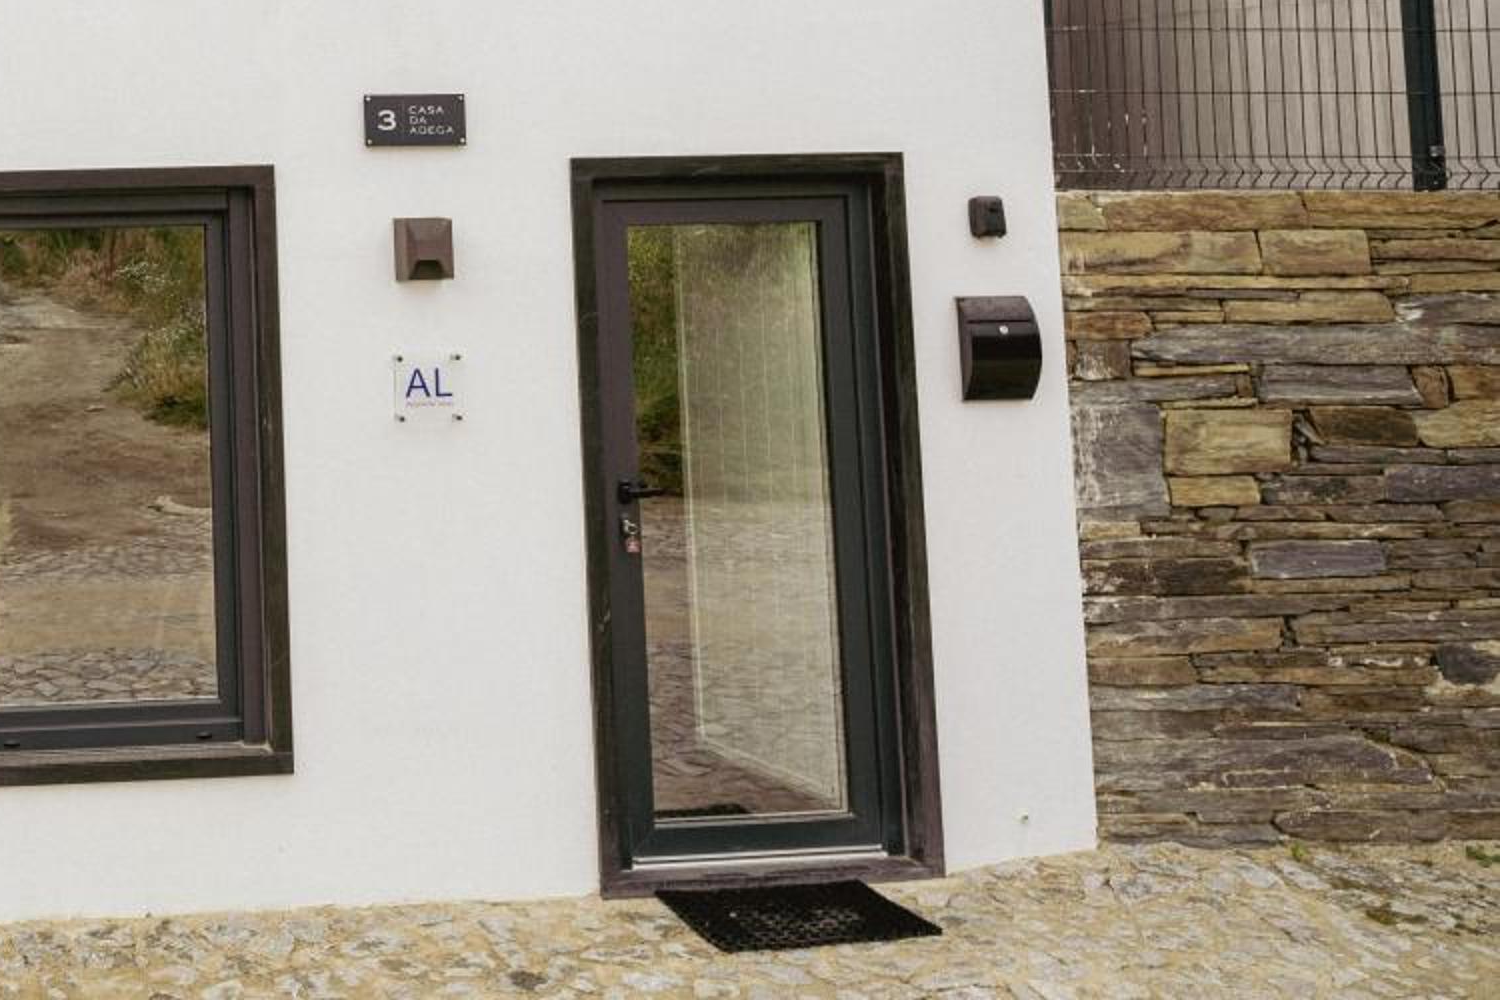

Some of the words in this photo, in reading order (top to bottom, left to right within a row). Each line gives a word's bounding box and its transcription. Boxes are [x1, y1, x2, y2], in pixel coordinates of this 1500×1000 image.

[408, 105, 444, 115] CASA
[377, 109, 397, 131] 3
[409, 116, 427, 125] DA
[405, 367, 453, 398] AL
